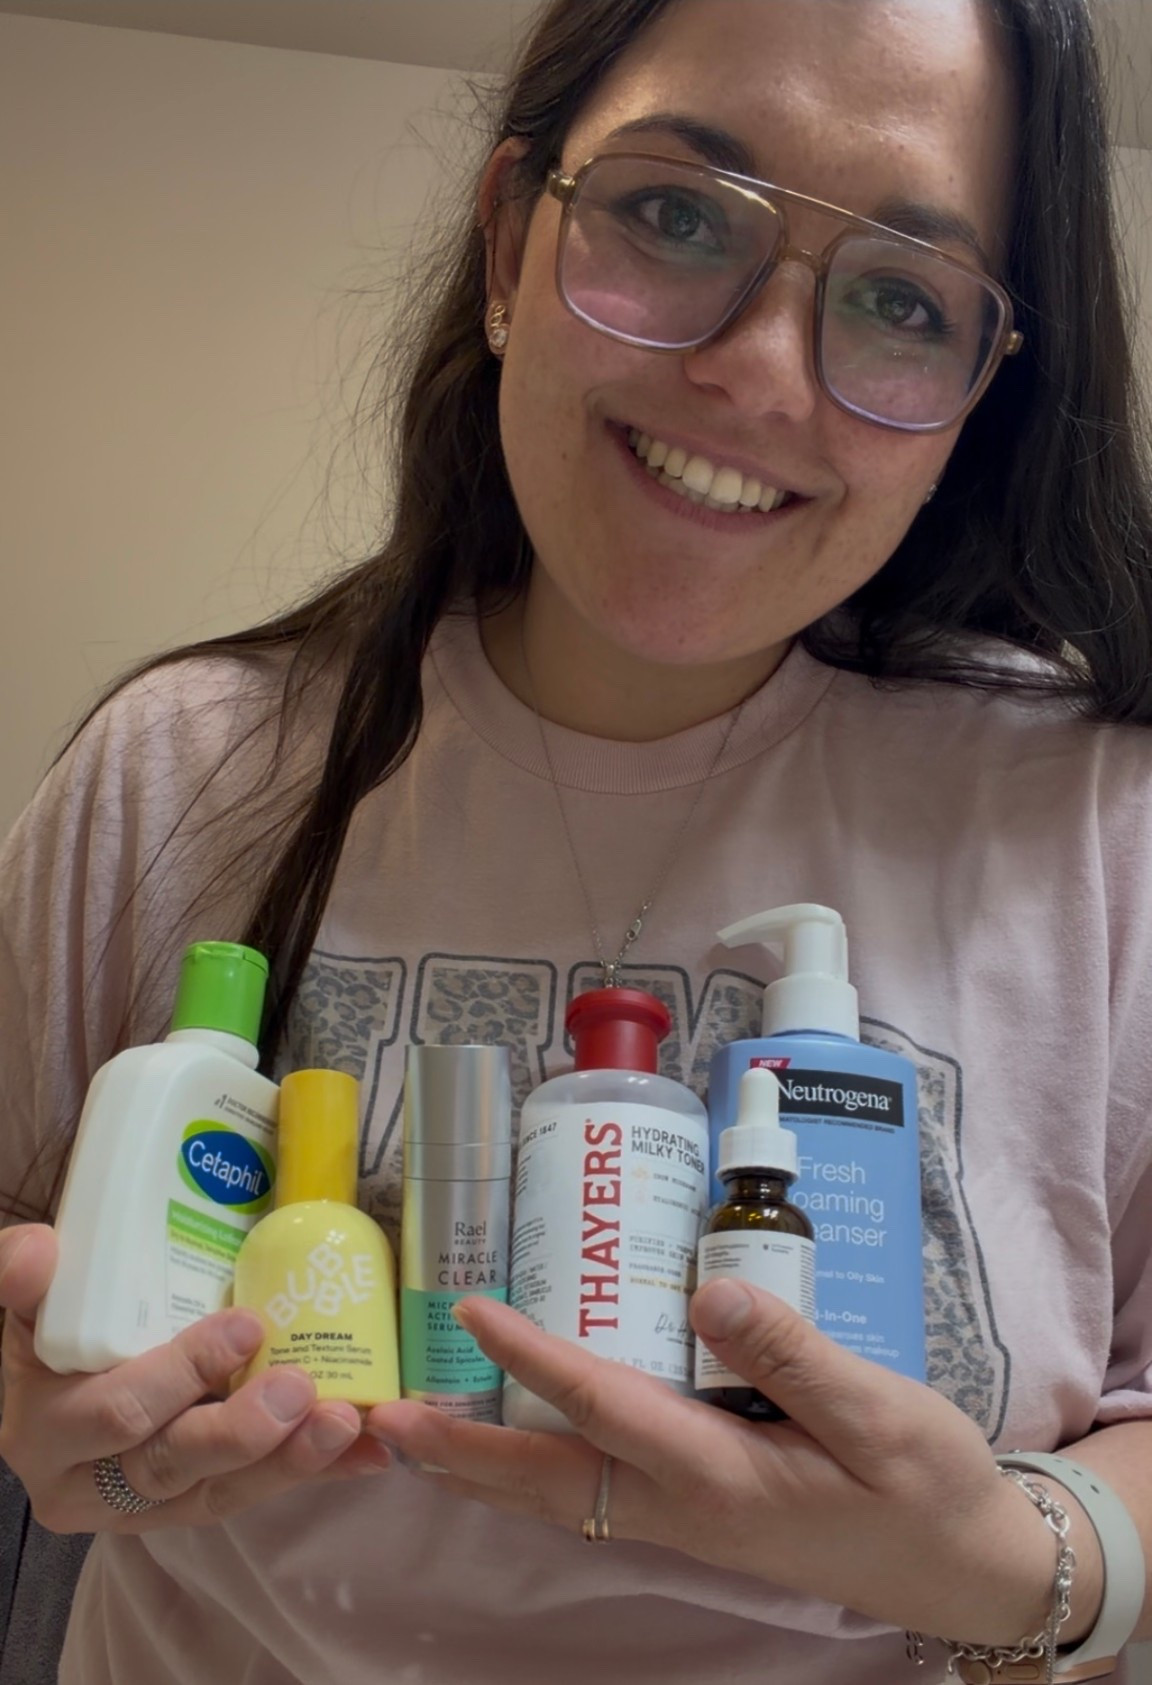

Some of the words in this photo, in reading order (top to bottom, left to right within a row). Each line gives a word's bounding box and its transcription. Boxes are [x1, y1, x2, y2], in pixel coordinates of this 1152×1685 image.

[759, 1060, 783, 1068] NEW
[779, 1079, 889, 1111] Neutrogena
[779, 1116, 821, 1124] MATOLOGIST
[540, 1122, 557, 1135] 1847
[631, 1125, 700, 1157] HYDRATING
[631, 1140, 673, 1159] MILKY
[677, 1149, 705, 1176] TONER
[188, 1140, 263, 1196] Cetaphil
[798, 1156, 866, 1184] Fresh
[792, 1190, 885, 1224] oaming
[455, 1220, 486, 1236] Rael
[579, 1122, 623, 1338] THAYERS
[438, 1250, 498, 1265] MIRACLE
[438, 1269, 497, 1286] CLEAR
[835, 1271, 845, 1279] to
[846, 1271, 864, 1283] Oily
[865, 1273, 885, 1283] Skin
[266, 1243, 377, 1330] BUBBLE
[815, 1309, 867, 1324] l-In-One
[290, 1333, 313, 1341] DAY
[314, 1332, 353, 1341] DREAM
[270, 1346, 290, 1355] Tone
[311, 1343, 345, 1352] Texture
[346, 1344, 372, 1354] Serum
[457, 1346, 474, 1354] Acid
[302, 1355, 311, 1365] C
[327, 1371, 338, 1379] 30
